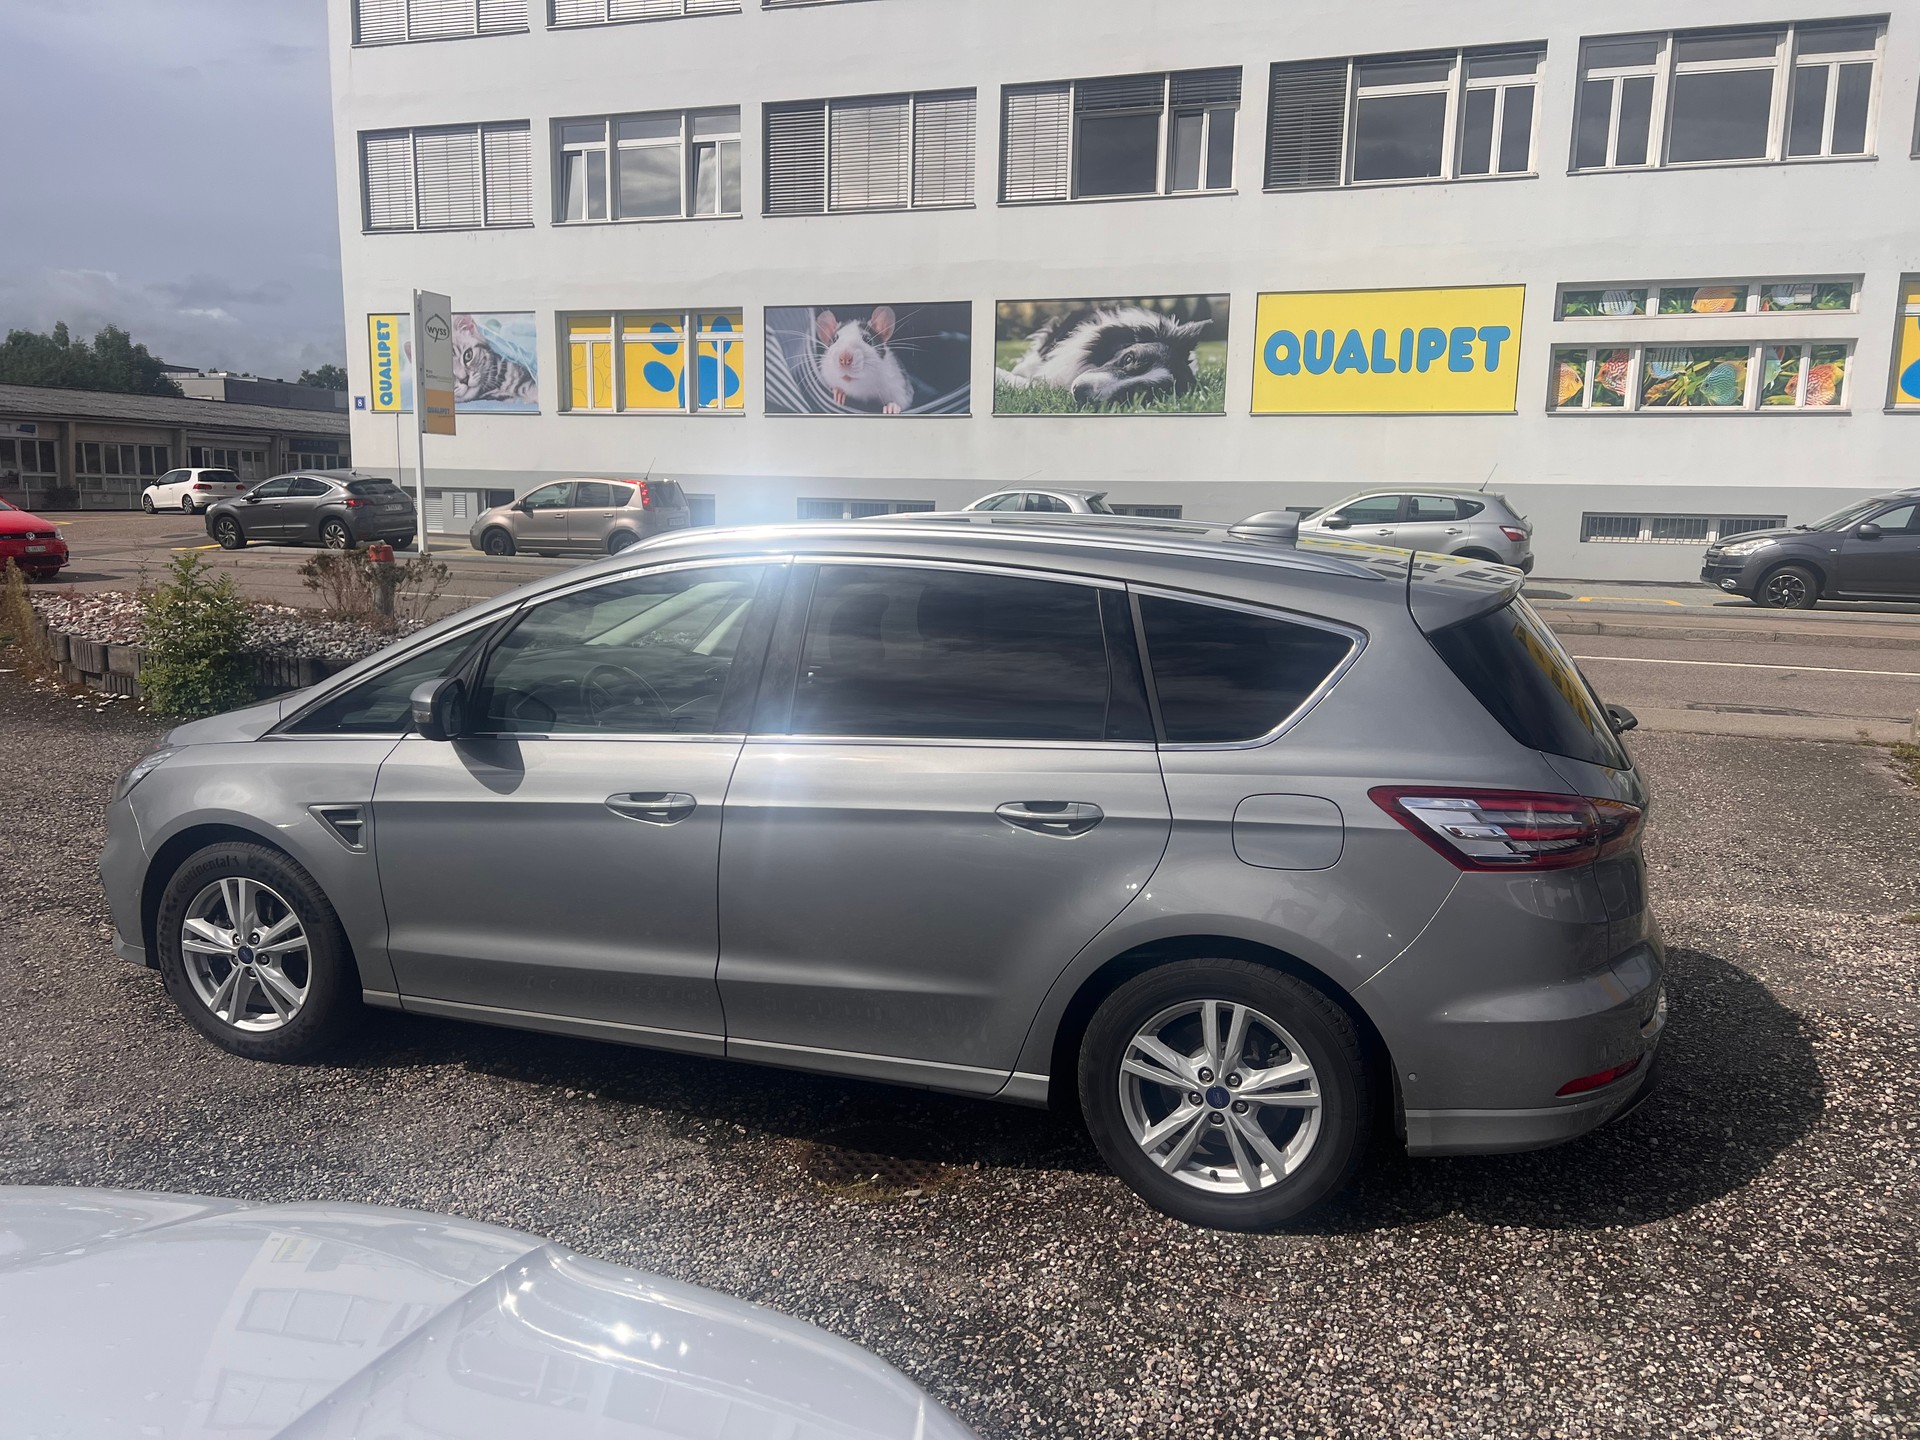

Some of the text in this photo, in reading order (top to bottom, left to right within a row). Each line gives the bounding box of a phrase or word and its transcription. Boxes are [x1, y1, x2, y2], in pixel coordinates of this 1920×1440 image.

[427, 326, 447, 343] wyss
[1264, 326, 1511, 376] QUALIPET
[377, 320, 394, 406] QUALIPET
[357, 399, 363, 407] 8
[175, 855, 230, 893] Continental
